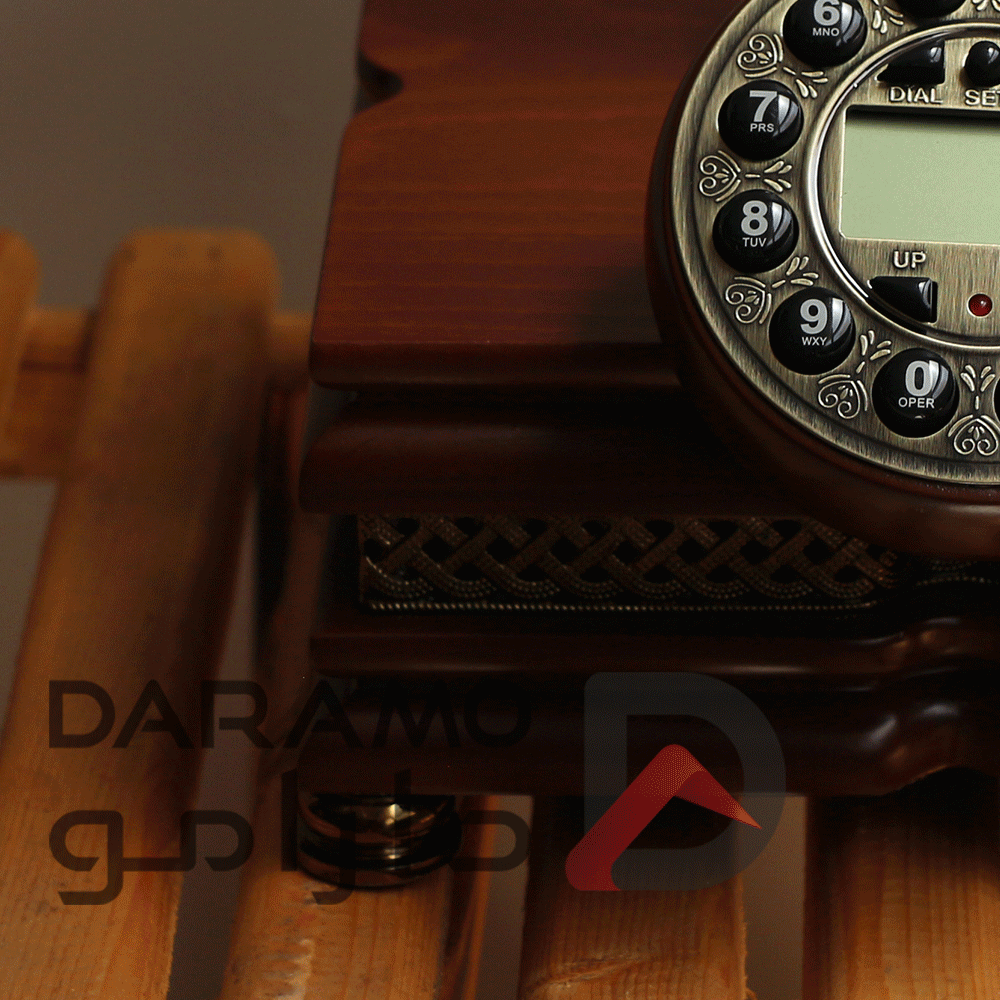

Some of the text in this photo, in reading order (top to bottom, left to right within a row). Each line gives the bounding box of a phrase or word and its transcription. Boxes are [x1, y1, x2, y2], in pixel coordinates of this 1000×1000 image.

[812, 27, 840, 37] MNO
[889, 86, 943, 104] DIAL
[749, 90, 777, 122] 7
[750, 123, 775, 133] PRS
[741, 200, 769, 236] 8
[742, 237, 767, 247] TUV
[893, 250, 927, 269] UP
[800, 298, 828, 334] 9
[801, 336, 828, 346] WXY
[905, 360, 933, 397] 0
[898, 397, 935, 409] OPER
